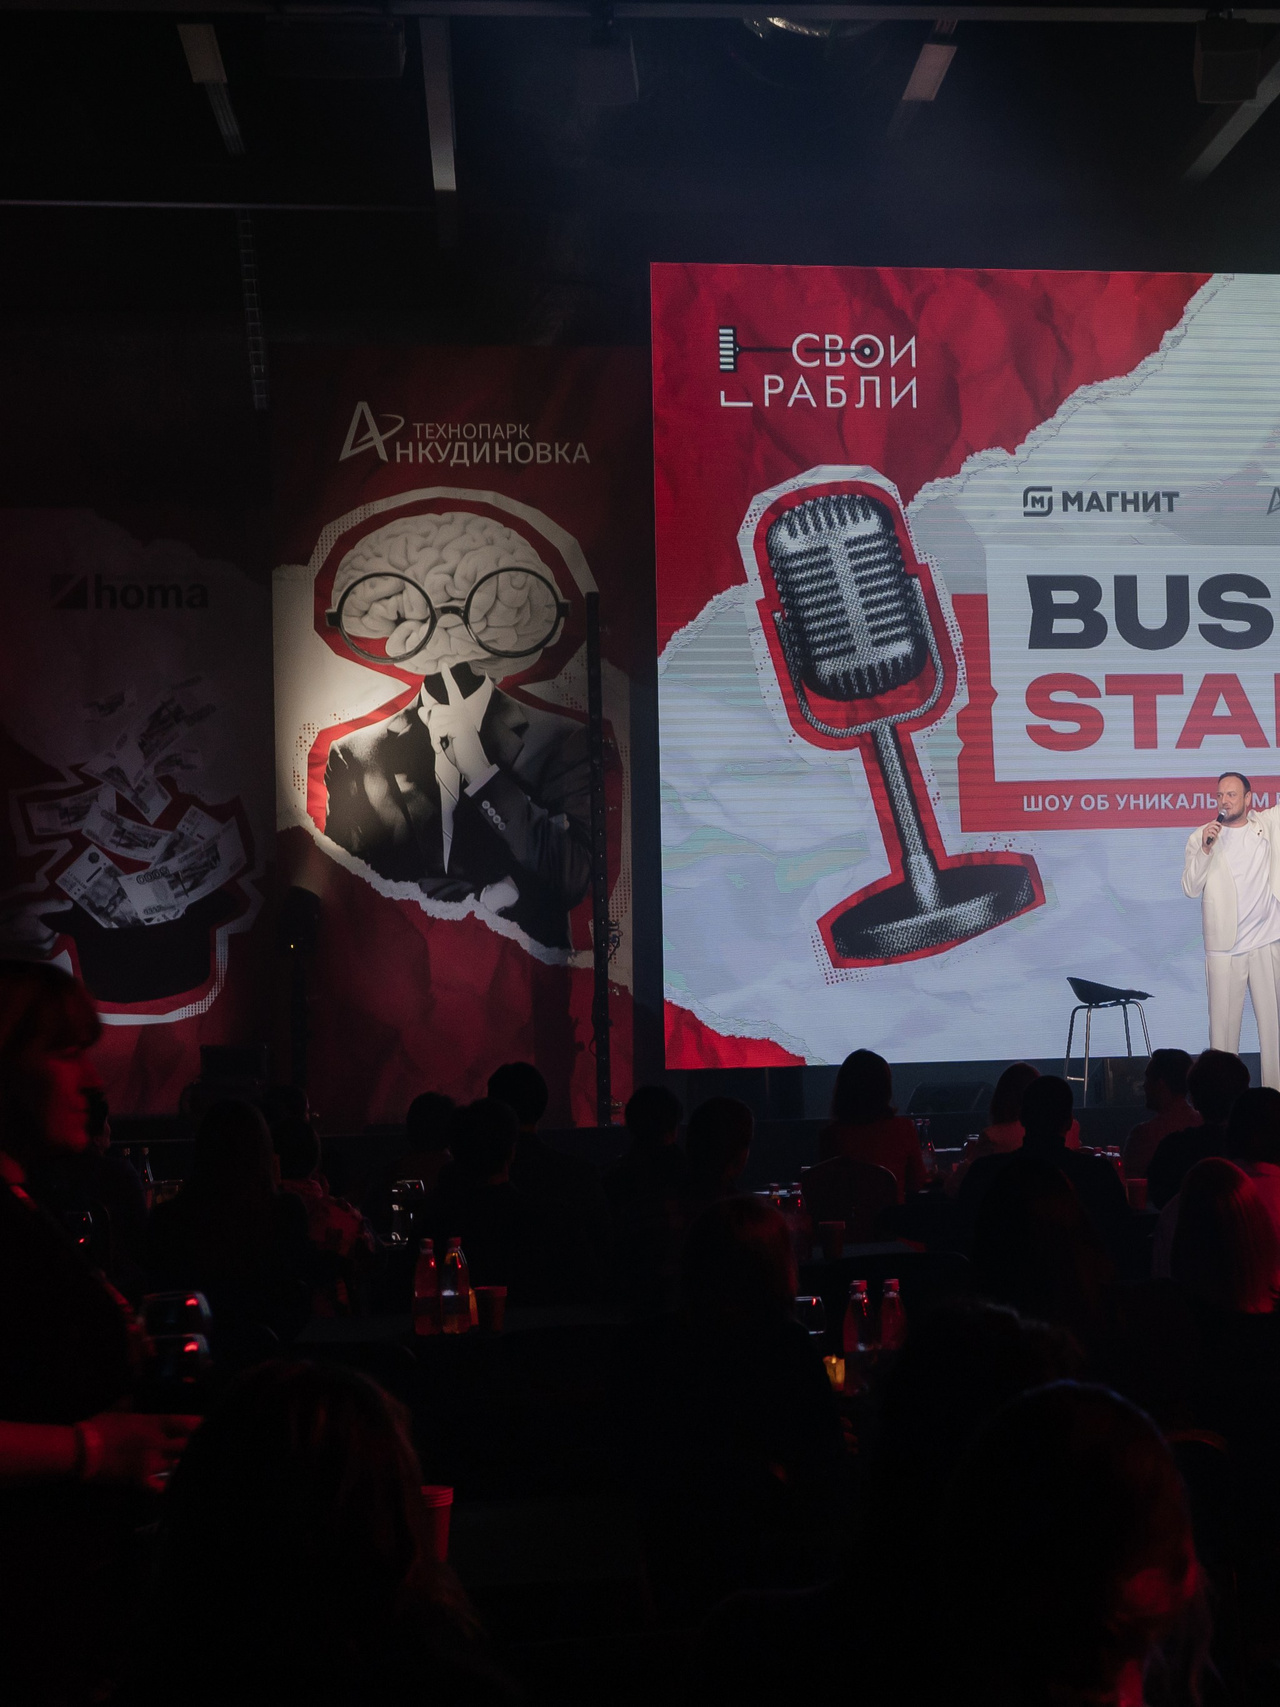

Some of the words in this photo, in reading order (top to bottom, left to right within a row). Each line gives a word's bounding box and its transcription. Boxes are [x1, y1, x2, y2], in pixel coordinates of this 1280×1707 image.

[792, 333, 917, 368] СВОИ
[412, 422, 531, 440] ТЕХНОПАРК
[1062, 491, 1180, 513] МАГНИТ
[94, 573, 209, 610] homa
[1023, 795, 1074, 812] ШОУ
[1080, 794, 1110, 811] ОБ
[1117, 792, 1270, 810] УНИКАЛЬМ
